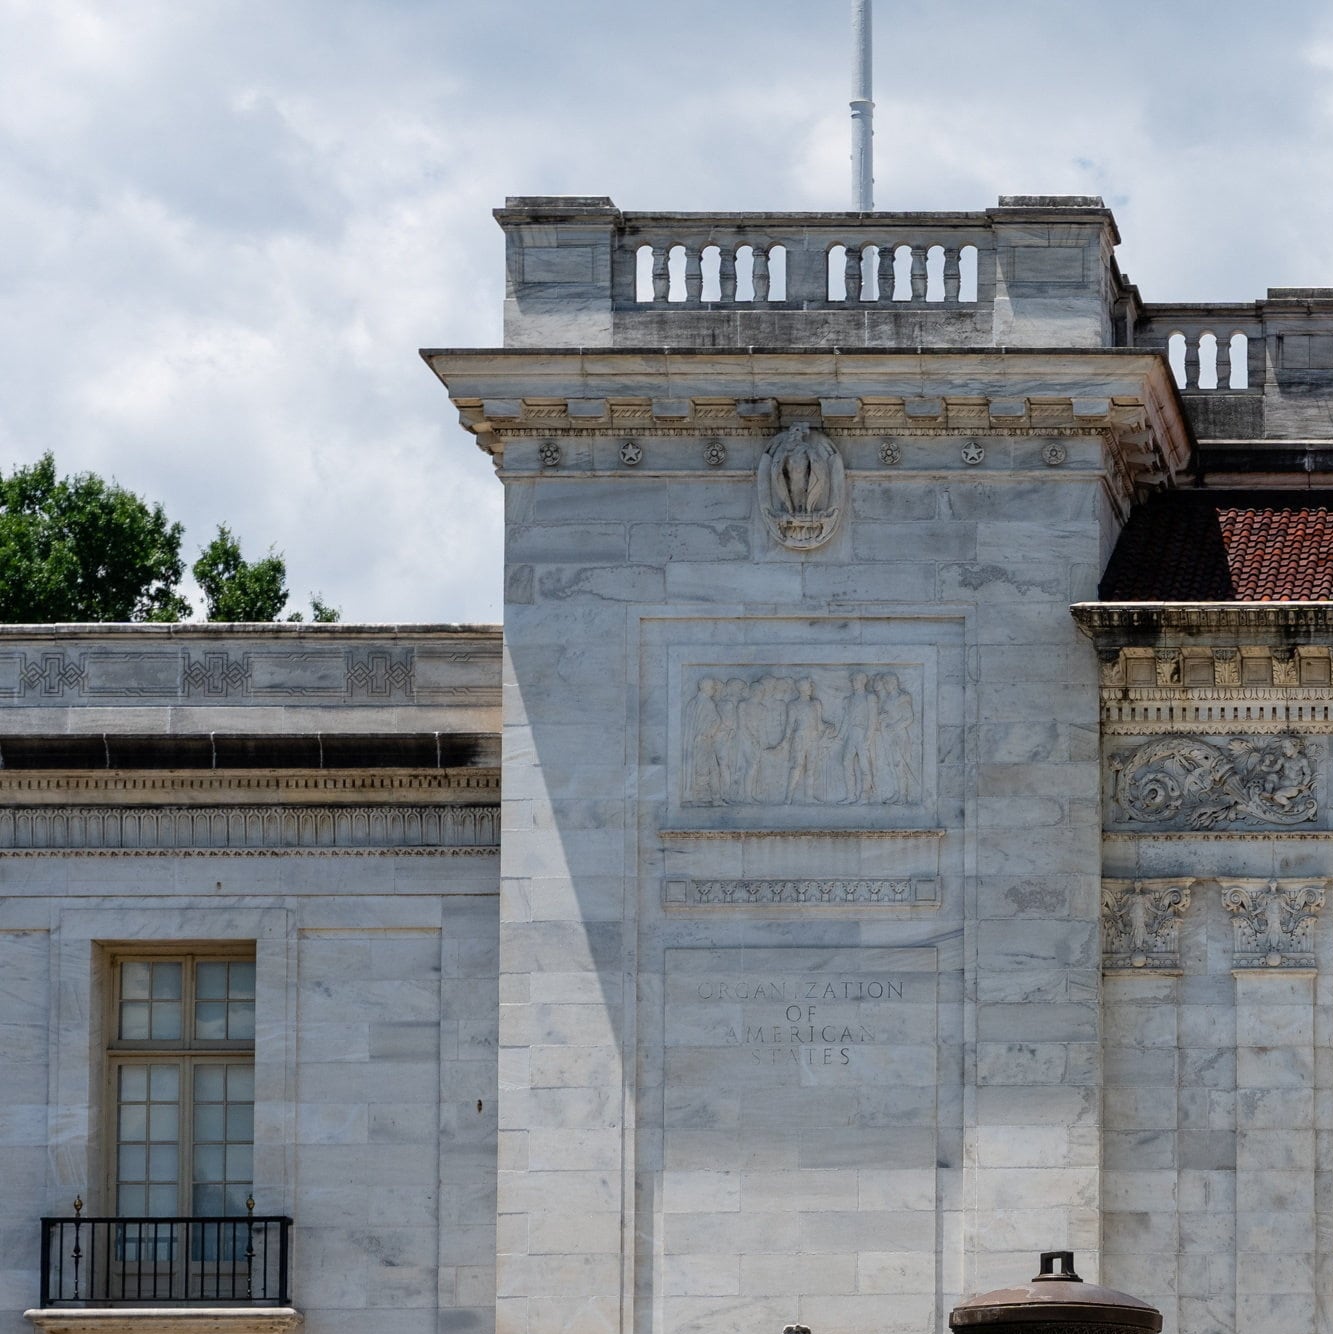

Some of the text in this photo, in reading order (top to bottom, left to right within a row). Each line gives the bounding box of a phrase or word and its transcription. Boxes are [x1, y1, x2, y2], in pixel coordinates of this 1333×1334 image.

[786, 1005, 816, 1022] OF
[726, 1025, 876, 1043] AMERICAN
[752, 1048, 850, 1065] STATES
